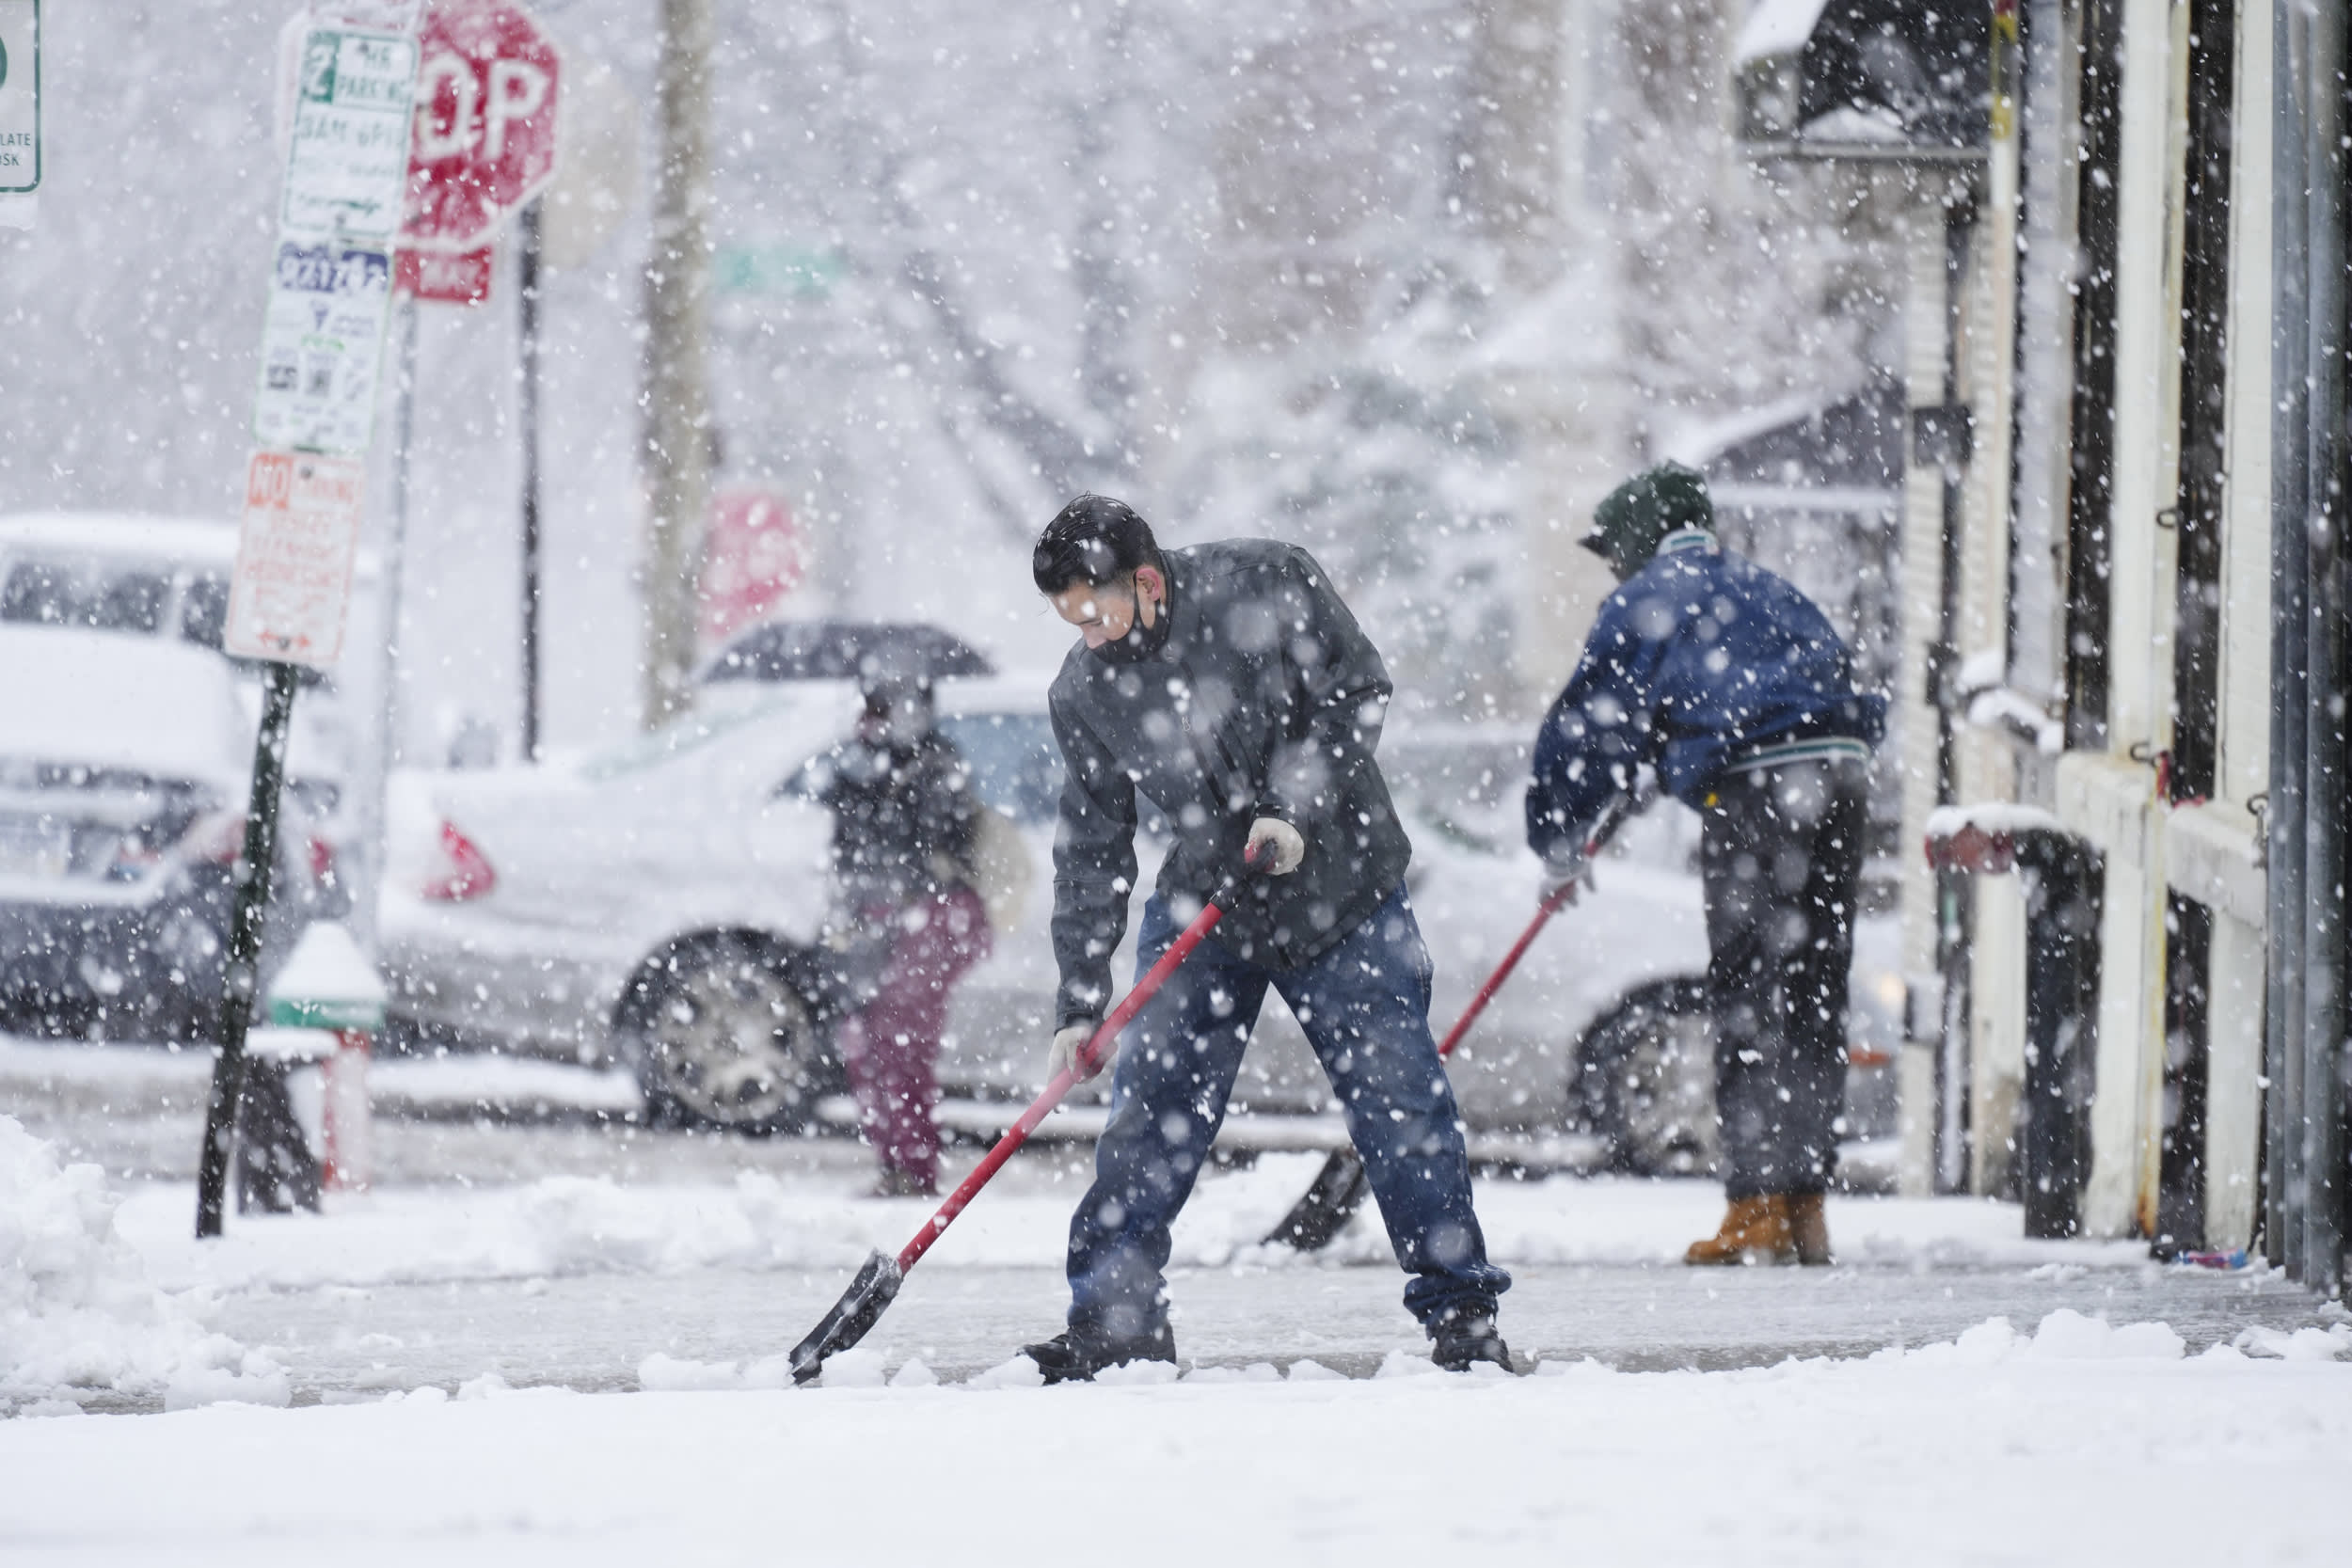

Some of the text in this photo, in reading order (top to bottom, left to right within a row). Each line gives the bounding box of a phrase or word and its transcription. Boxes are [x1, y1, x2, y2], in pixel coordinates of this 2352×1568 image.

[308, 45, 335, 94] 2
[418, 52, 548, 161] OP
[0, 133, 30, 146] LATE
[0, 152, 20, 166] SK
[253, 460, 289, 502] NO
